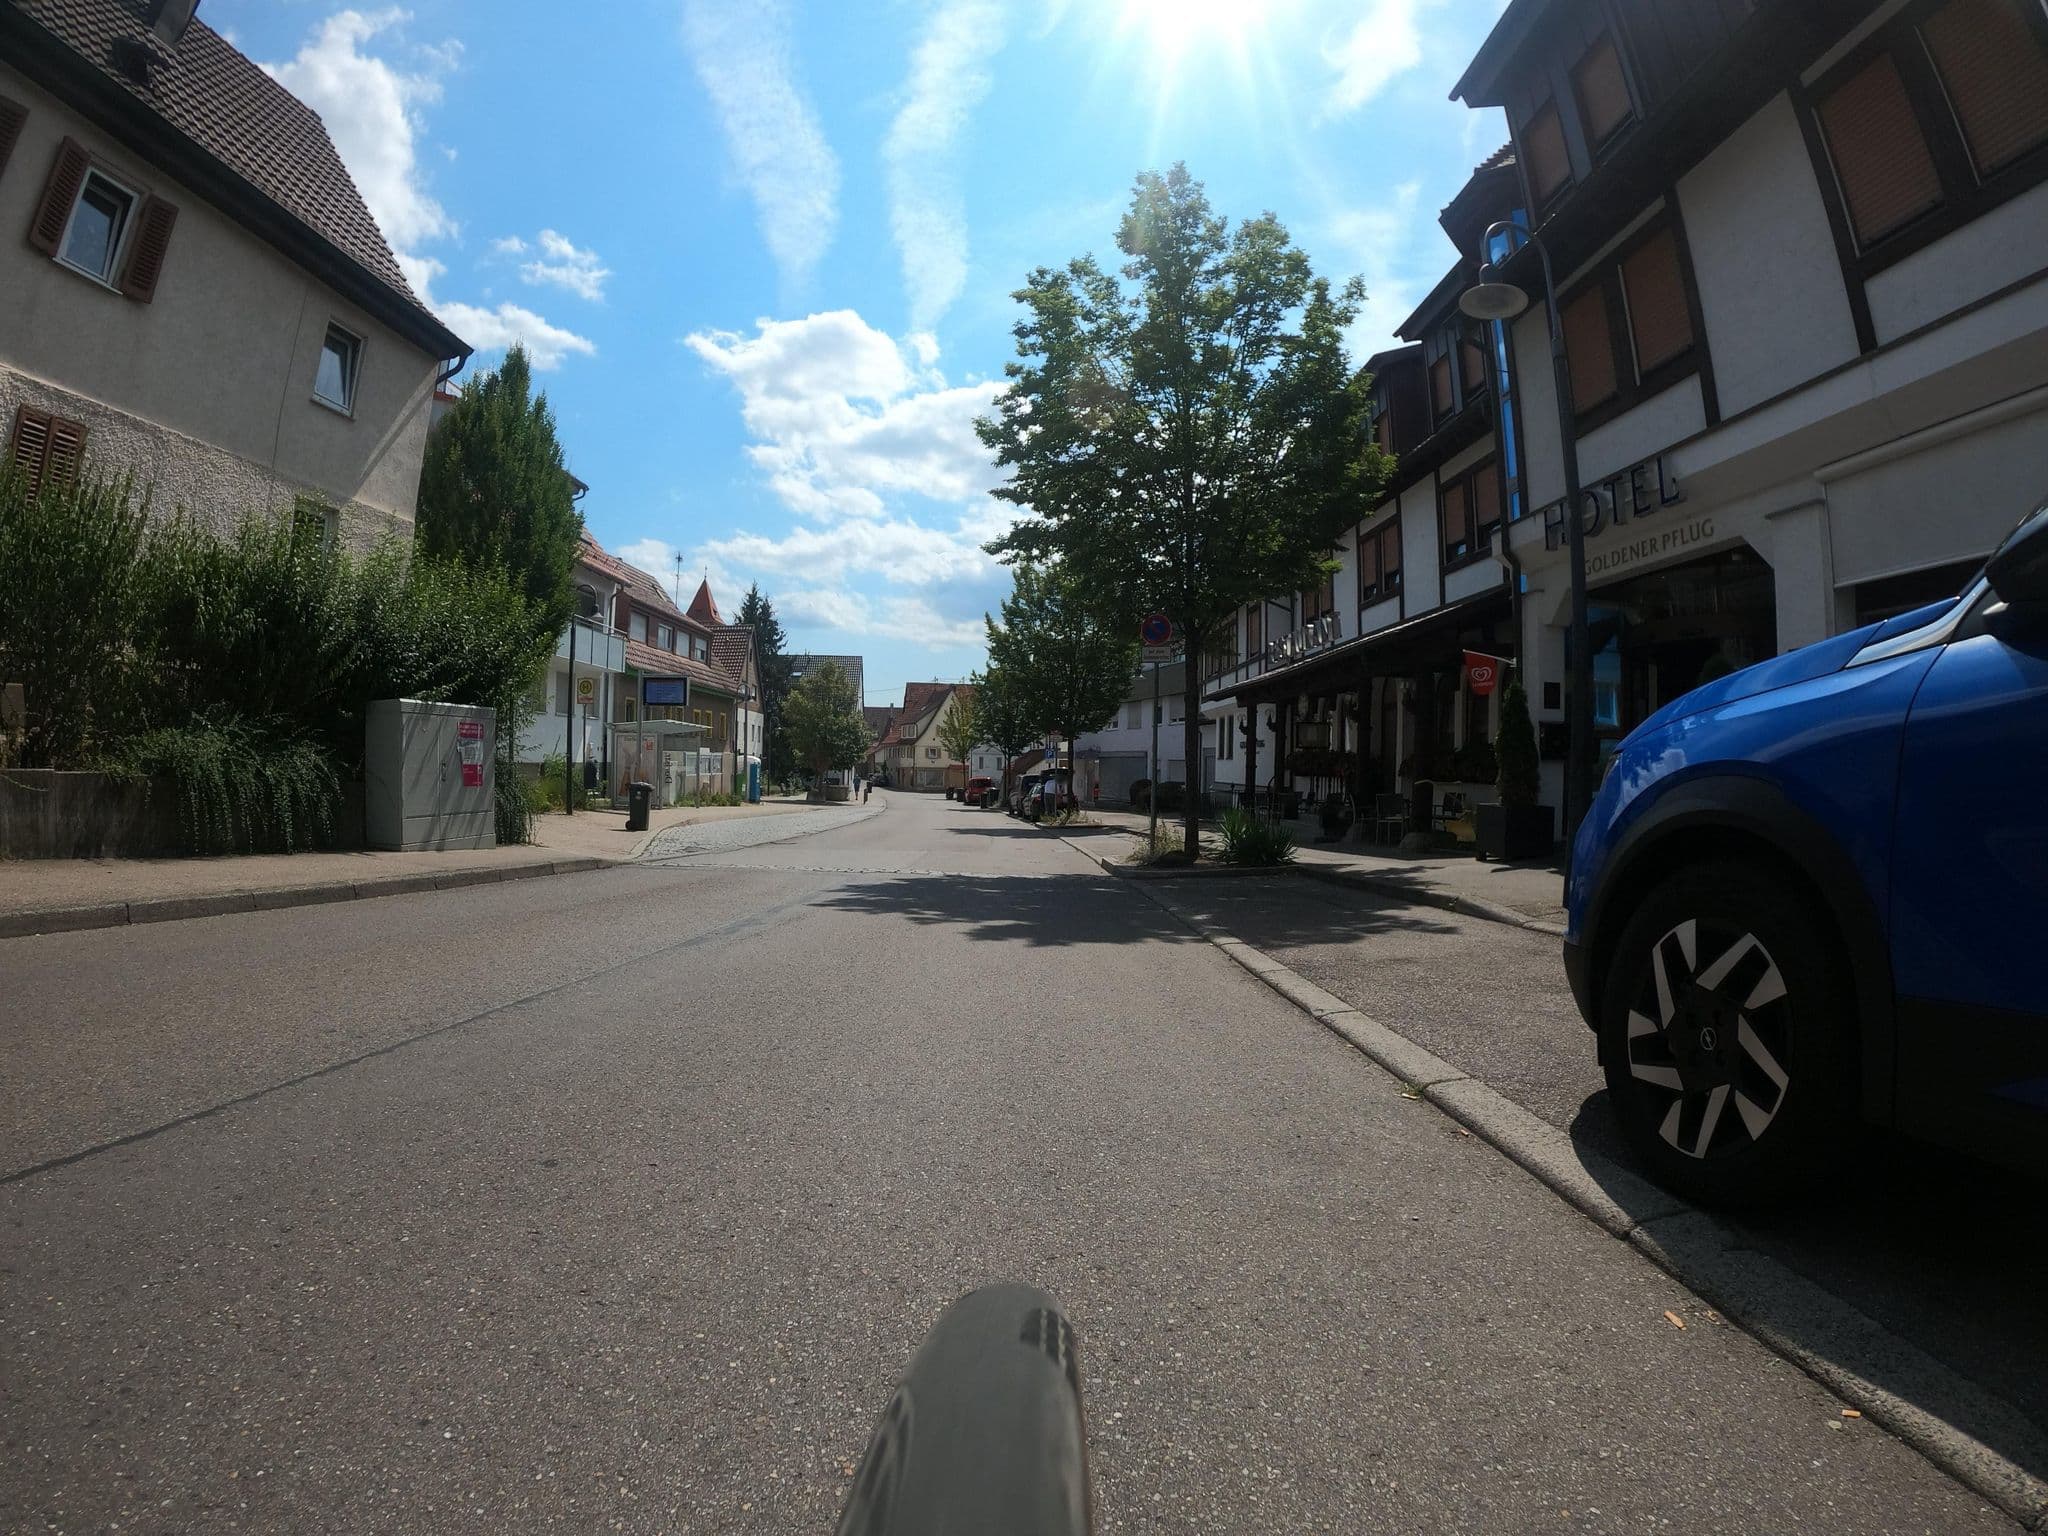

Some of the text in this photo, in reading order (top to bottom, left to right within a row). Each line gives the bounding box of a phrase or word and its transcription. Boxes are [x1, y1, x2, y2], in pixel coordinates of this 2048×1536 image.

[1544, 455, 1681, 551] HOTEL
[1585, 518, 1715, 577] GOLDENER PFLUG
